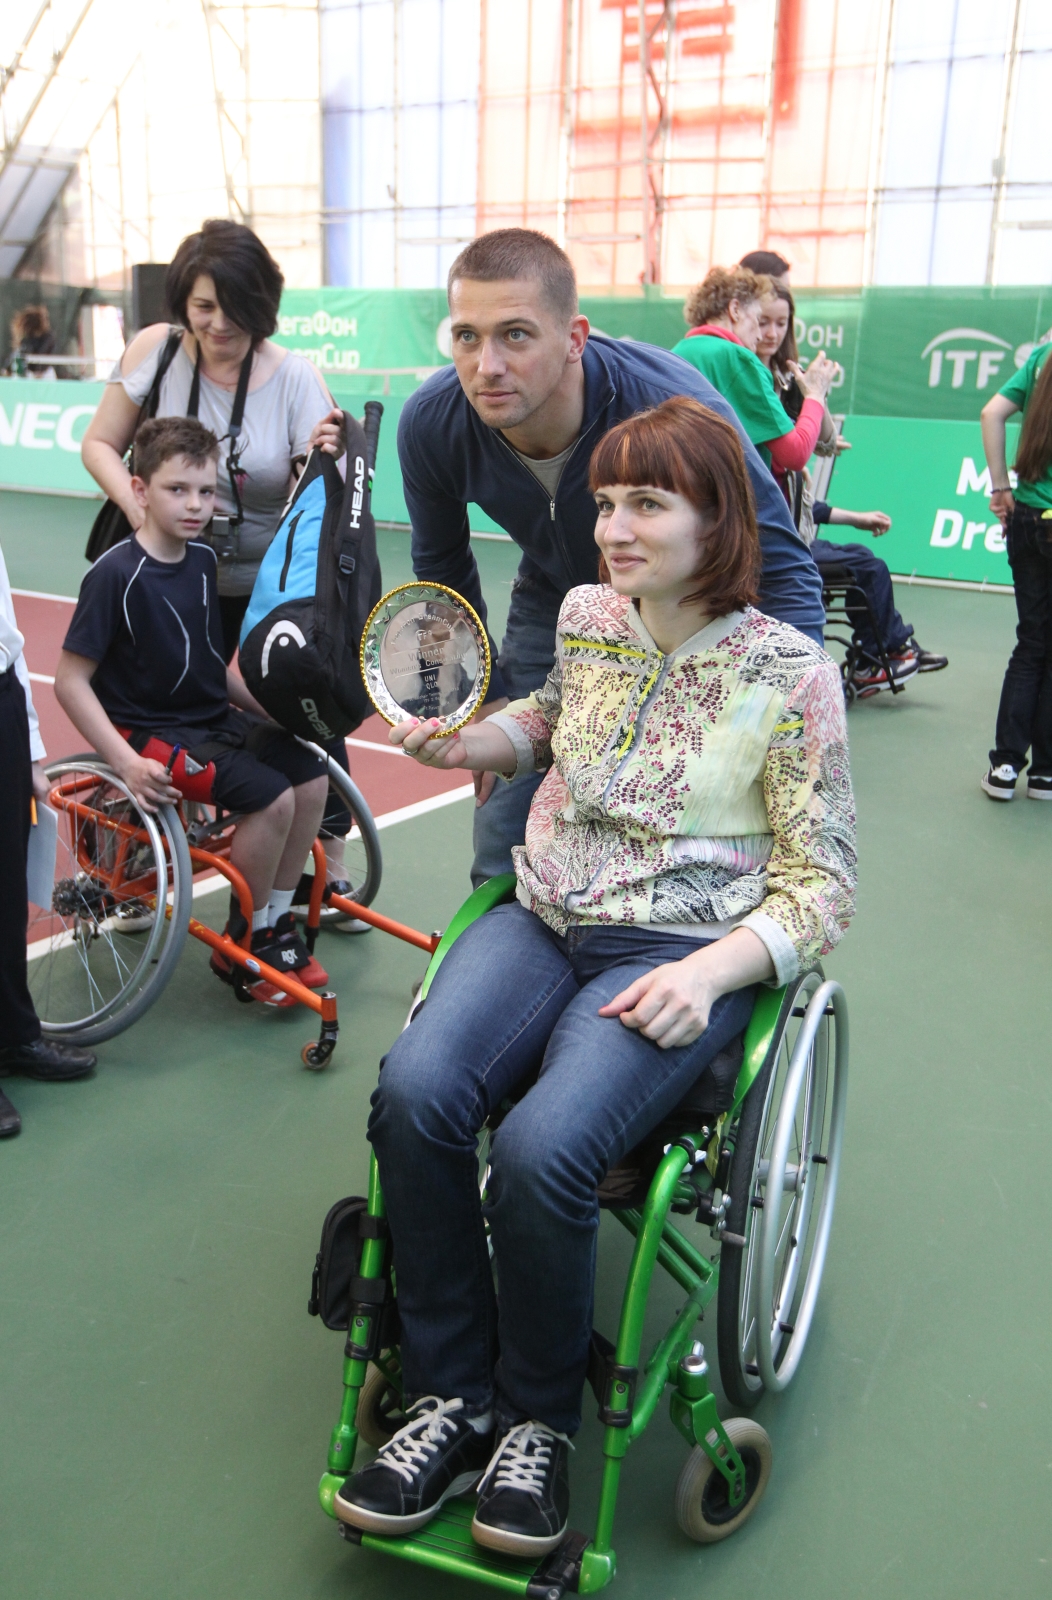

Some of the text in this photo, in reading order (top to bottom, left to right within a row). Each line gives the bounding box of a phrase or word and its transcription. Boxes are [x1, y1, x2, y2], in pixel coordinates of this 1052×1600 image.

[928, 350, 1006, 390] ITF
[349, 456, 365, 530] HEAD
[408, 648, 445, 662] Winner
[301, 698, 336, 740] HEAD
